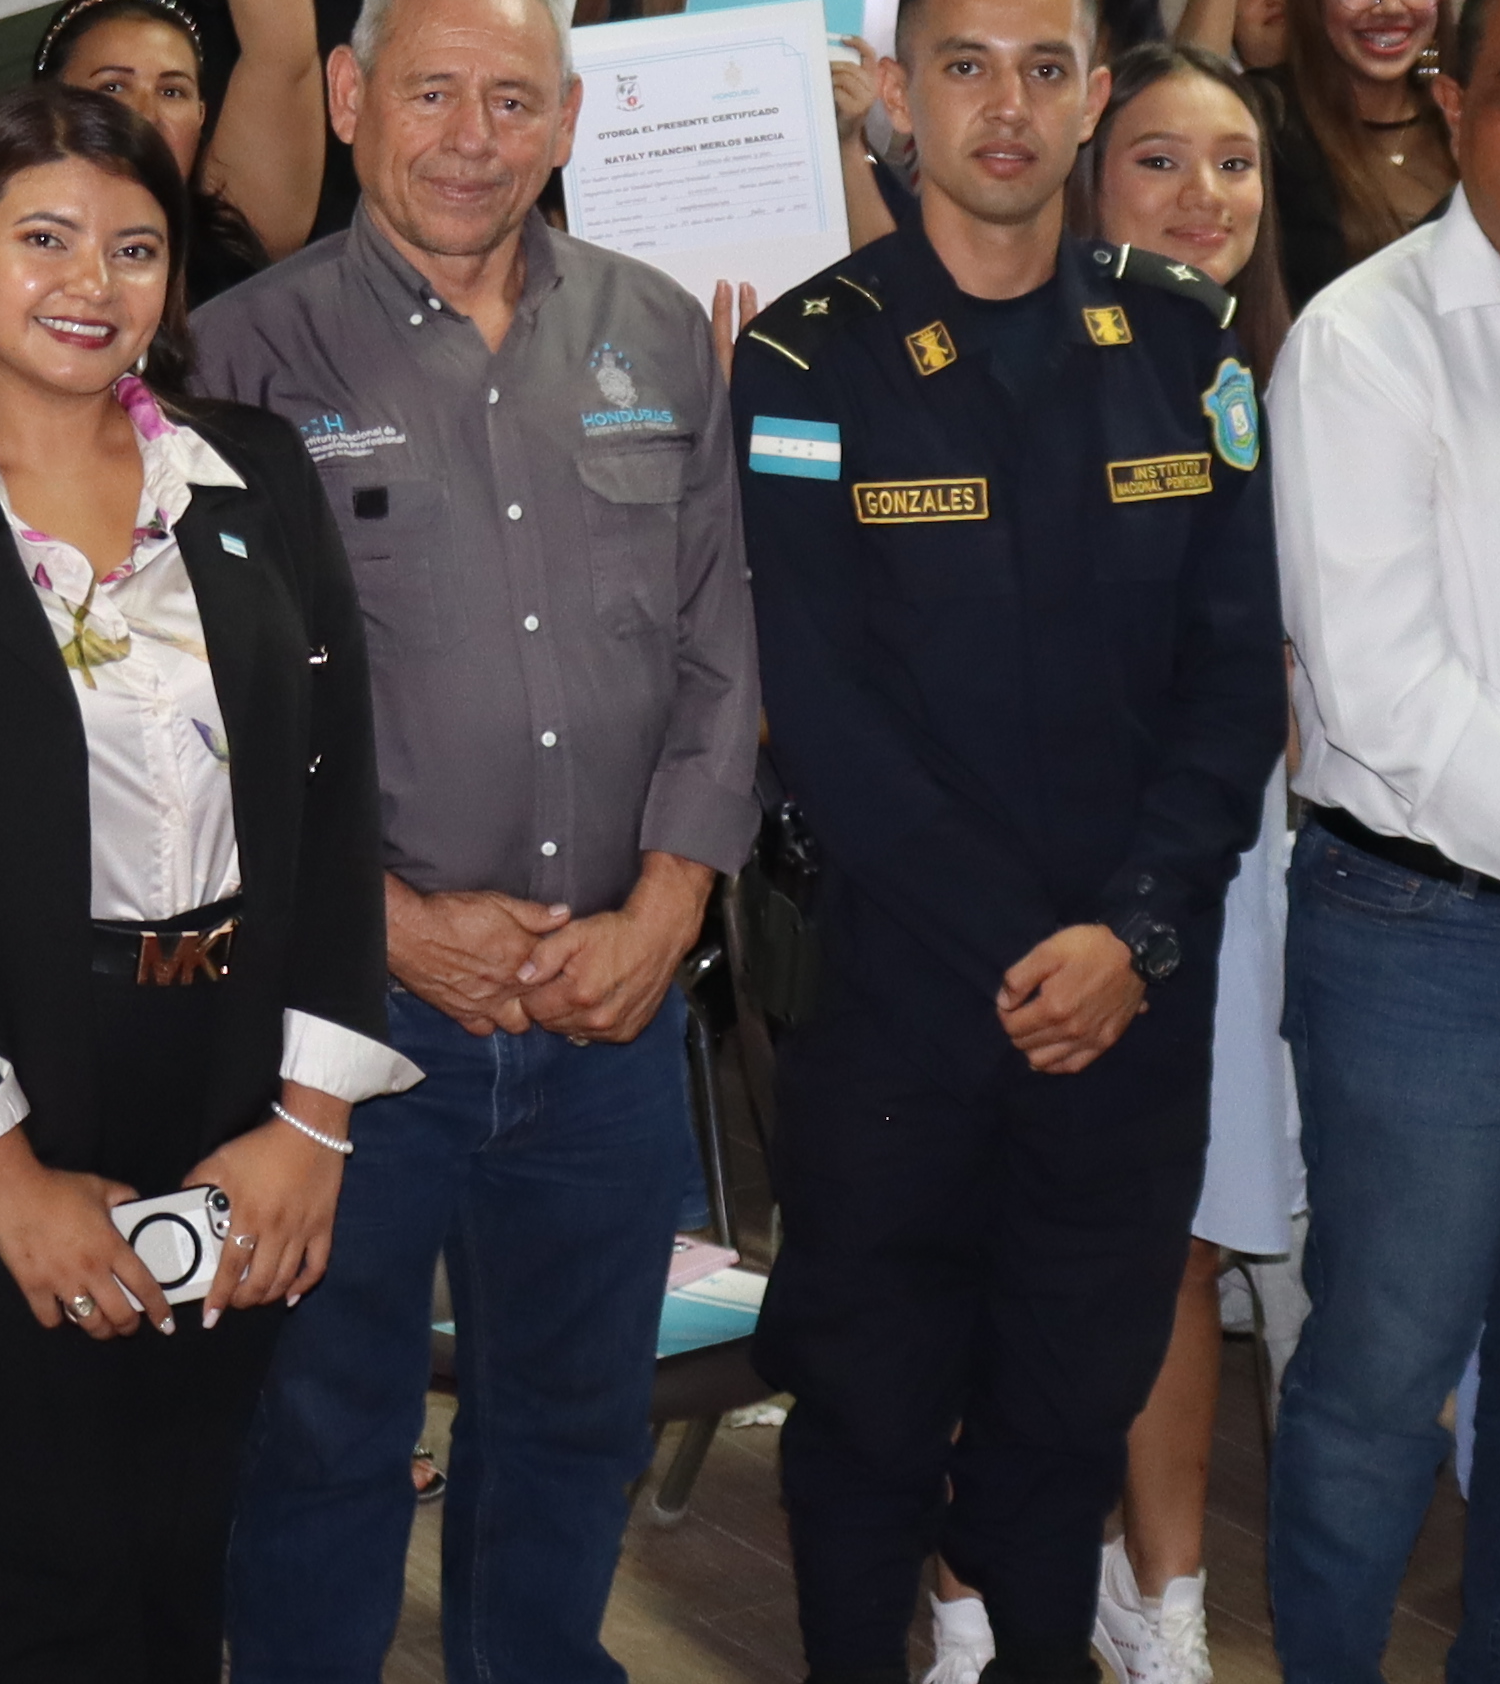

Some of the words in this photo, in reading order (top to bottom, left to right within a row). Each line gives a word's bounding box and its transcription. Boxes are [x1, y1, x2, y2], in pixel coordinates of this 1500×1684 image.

[598, 126, 640, 141] OTORGA
[642, 123, 655, 134] EL
[657, 116, 710, 132] PRESENTE
[712, 106, 780, 123] CERTIFICADO
[604, 152, 645, 165] NATALY
[648, 144, 697, 159] FRANCINI
[700, 138, 742, 152] MERLOS
[744, 132, 785, 145] MARCIA
[322, 414, 344, 433] H
[580, 408, 674, 428] HONDURAS
[865, 486, 976, 515] GONZALES
